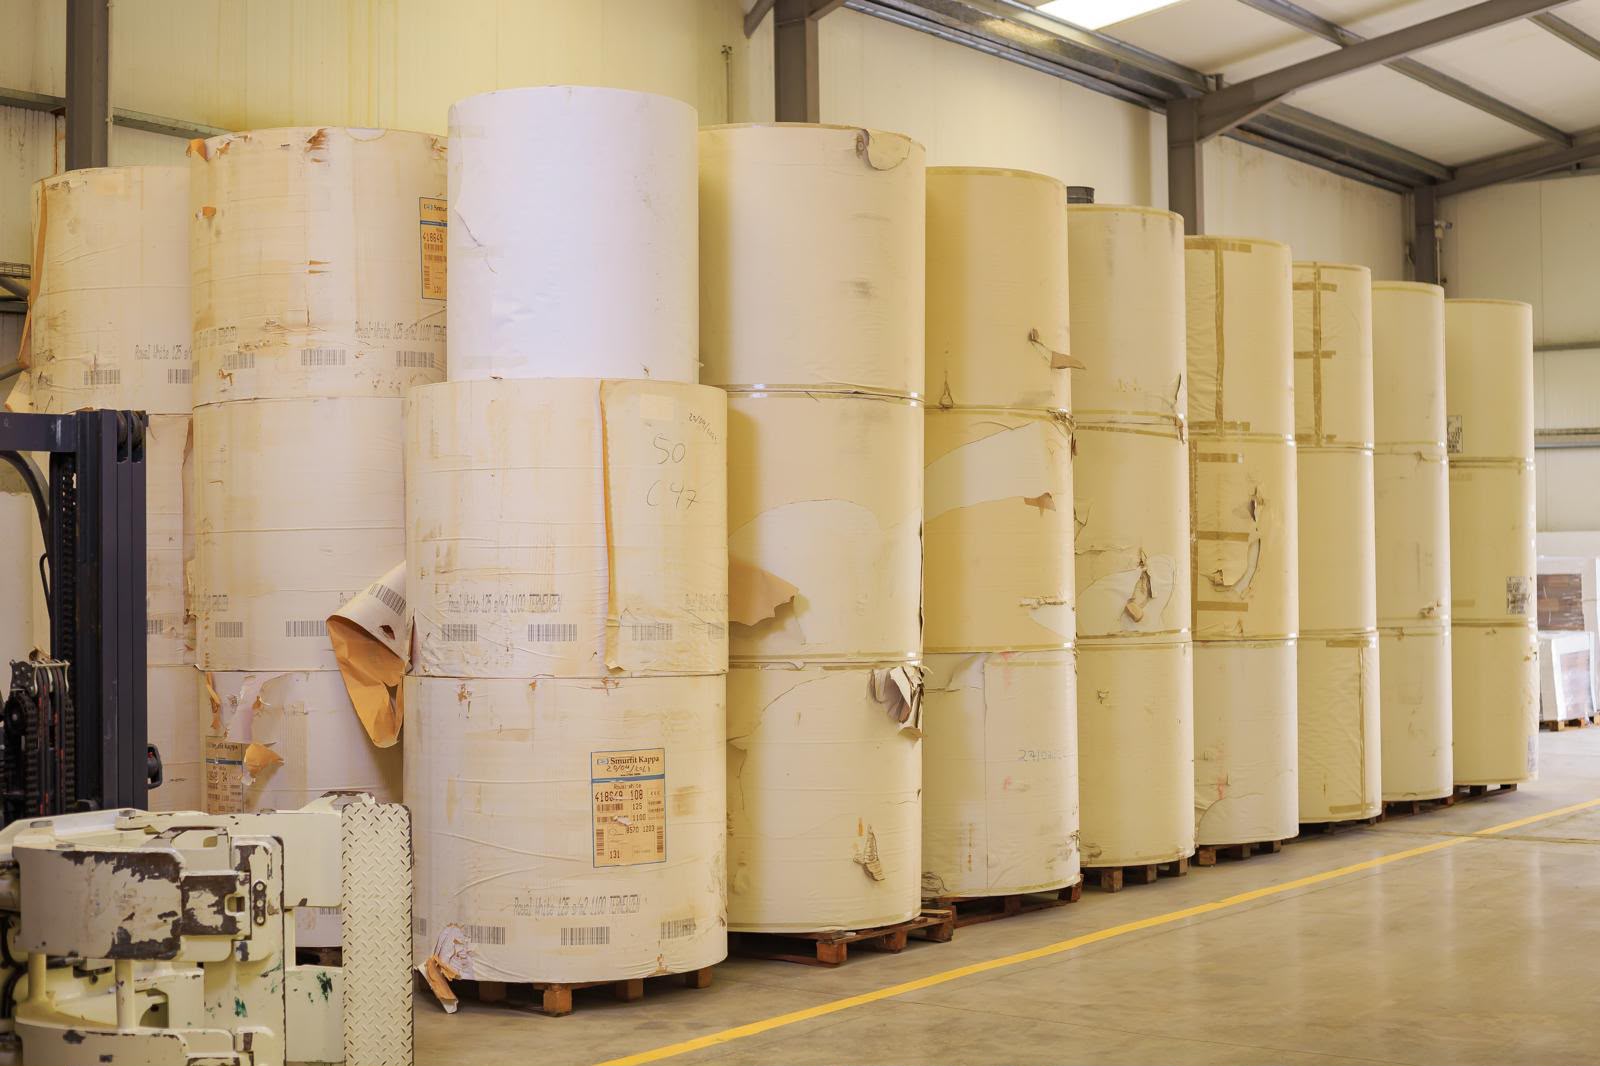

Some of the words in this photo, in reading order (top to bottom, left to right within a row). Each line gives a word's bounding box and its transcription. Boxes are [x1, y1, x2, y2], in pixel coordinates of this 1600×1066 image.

[653, 432, 686, 465] 50
[610, 756, 637, 765] Smurfit
[638, 755, 660, 765] Kappa
